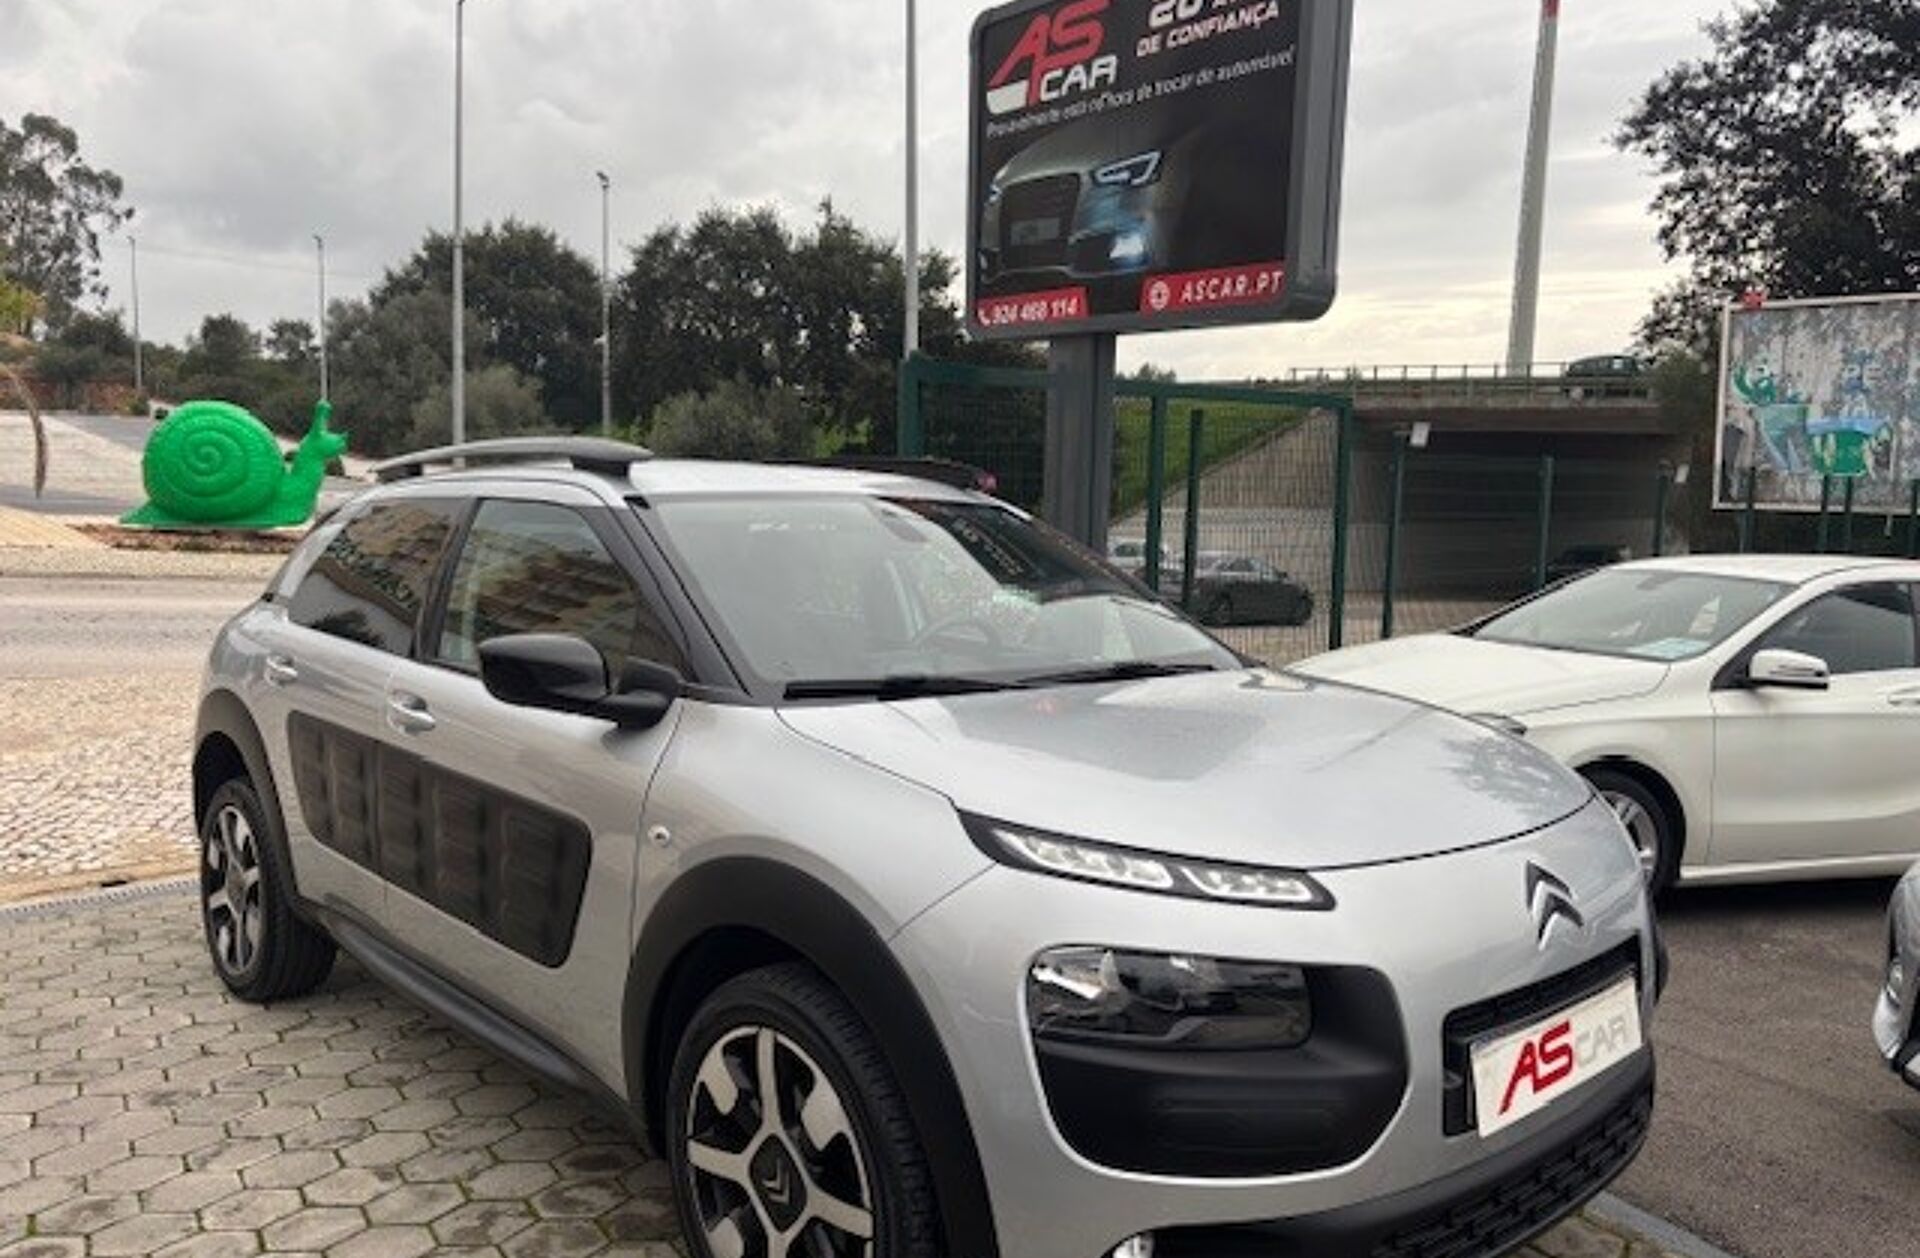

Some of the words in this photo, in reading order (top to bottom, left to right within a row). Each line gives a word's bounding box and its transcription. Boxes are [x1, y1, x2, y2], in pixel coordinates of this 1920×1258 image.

[988, 0, 1112, 107] AS
[1136, 32, 1161, 57] DE
[1166, 0, 1279, 49] CONFIANÇA
[1040, 54, 1118, 102] CAR
[1154, 73, 1194, 96] trocar
[1499, 1019, 1574, 1116] AS
[1574, 1015, 1628, 1068] CAR
